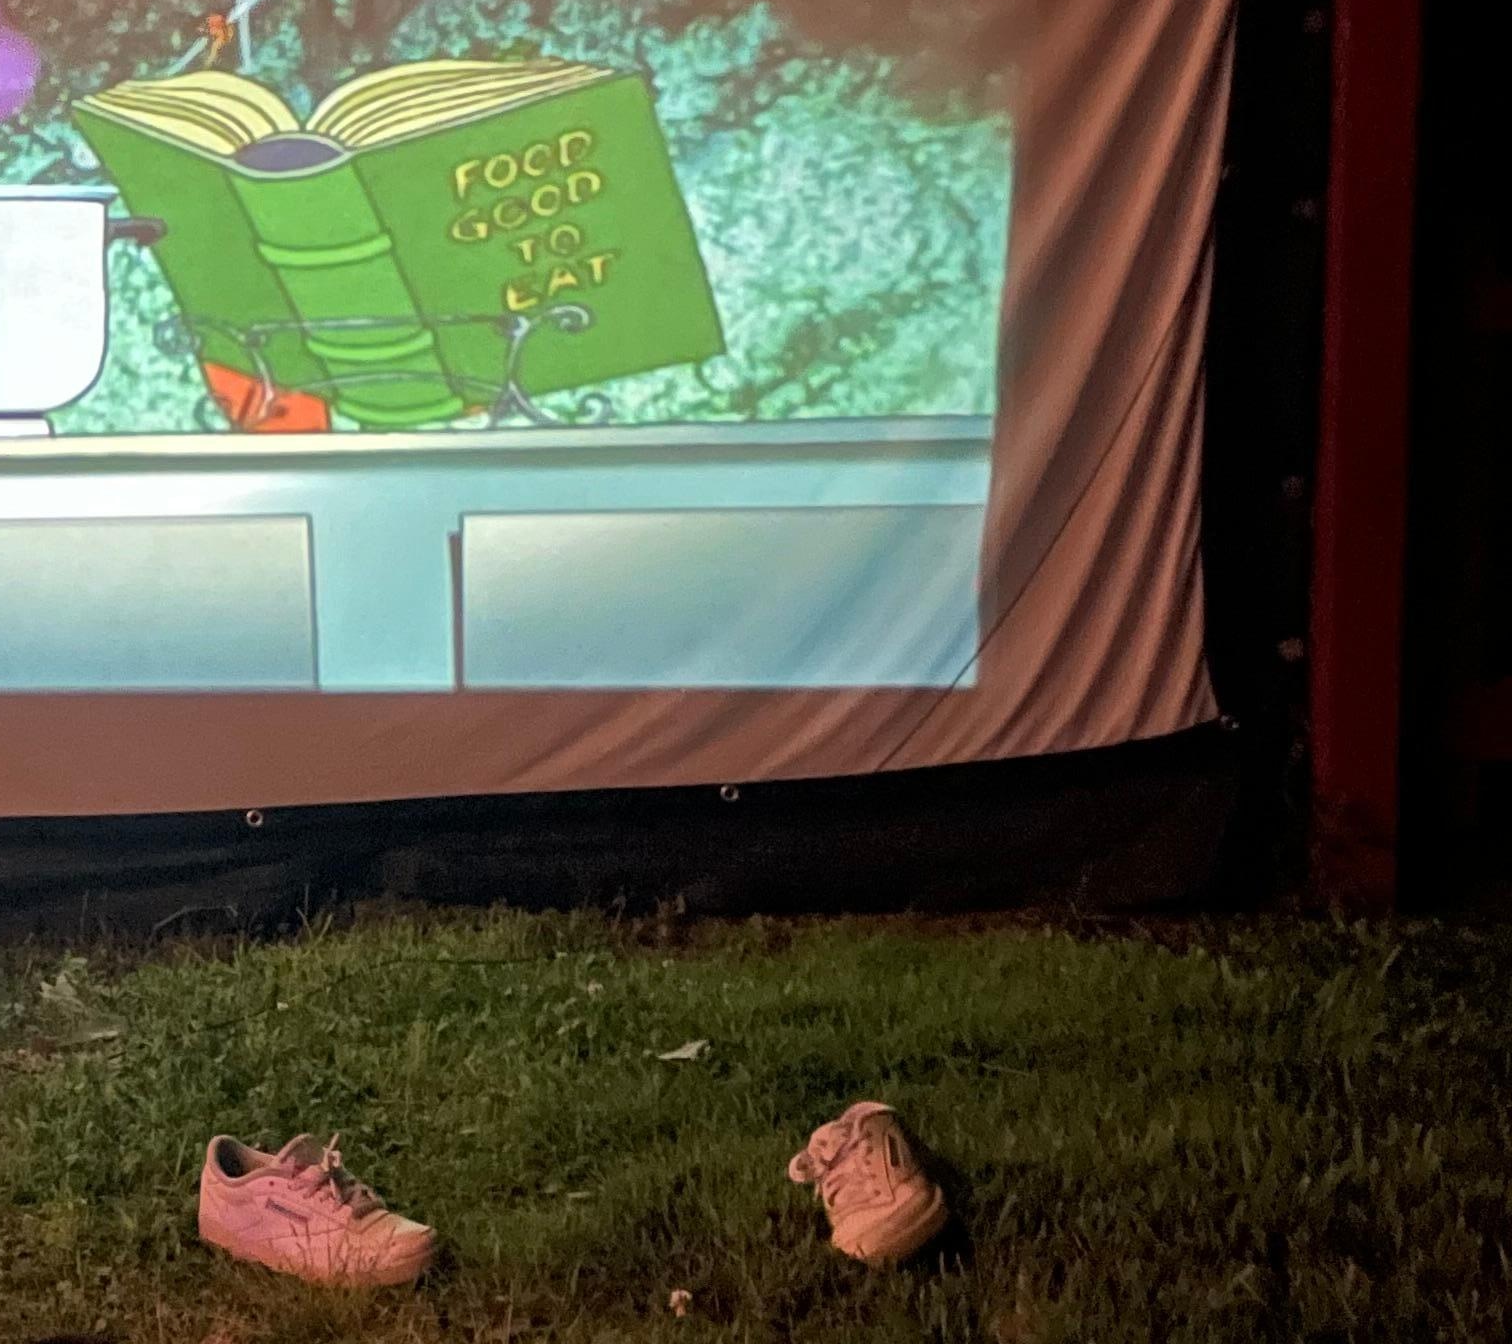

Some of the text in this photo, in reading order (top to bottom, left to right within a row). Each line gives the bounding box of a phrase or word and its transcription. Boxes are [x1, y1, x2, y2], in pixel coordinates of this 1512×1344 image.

[453, 130, 592, 198] FOOD
[451, 170, 601, 242] GOOD
[512, 223, 580, 263] TO
[505, 253, 617, 311] EAT
